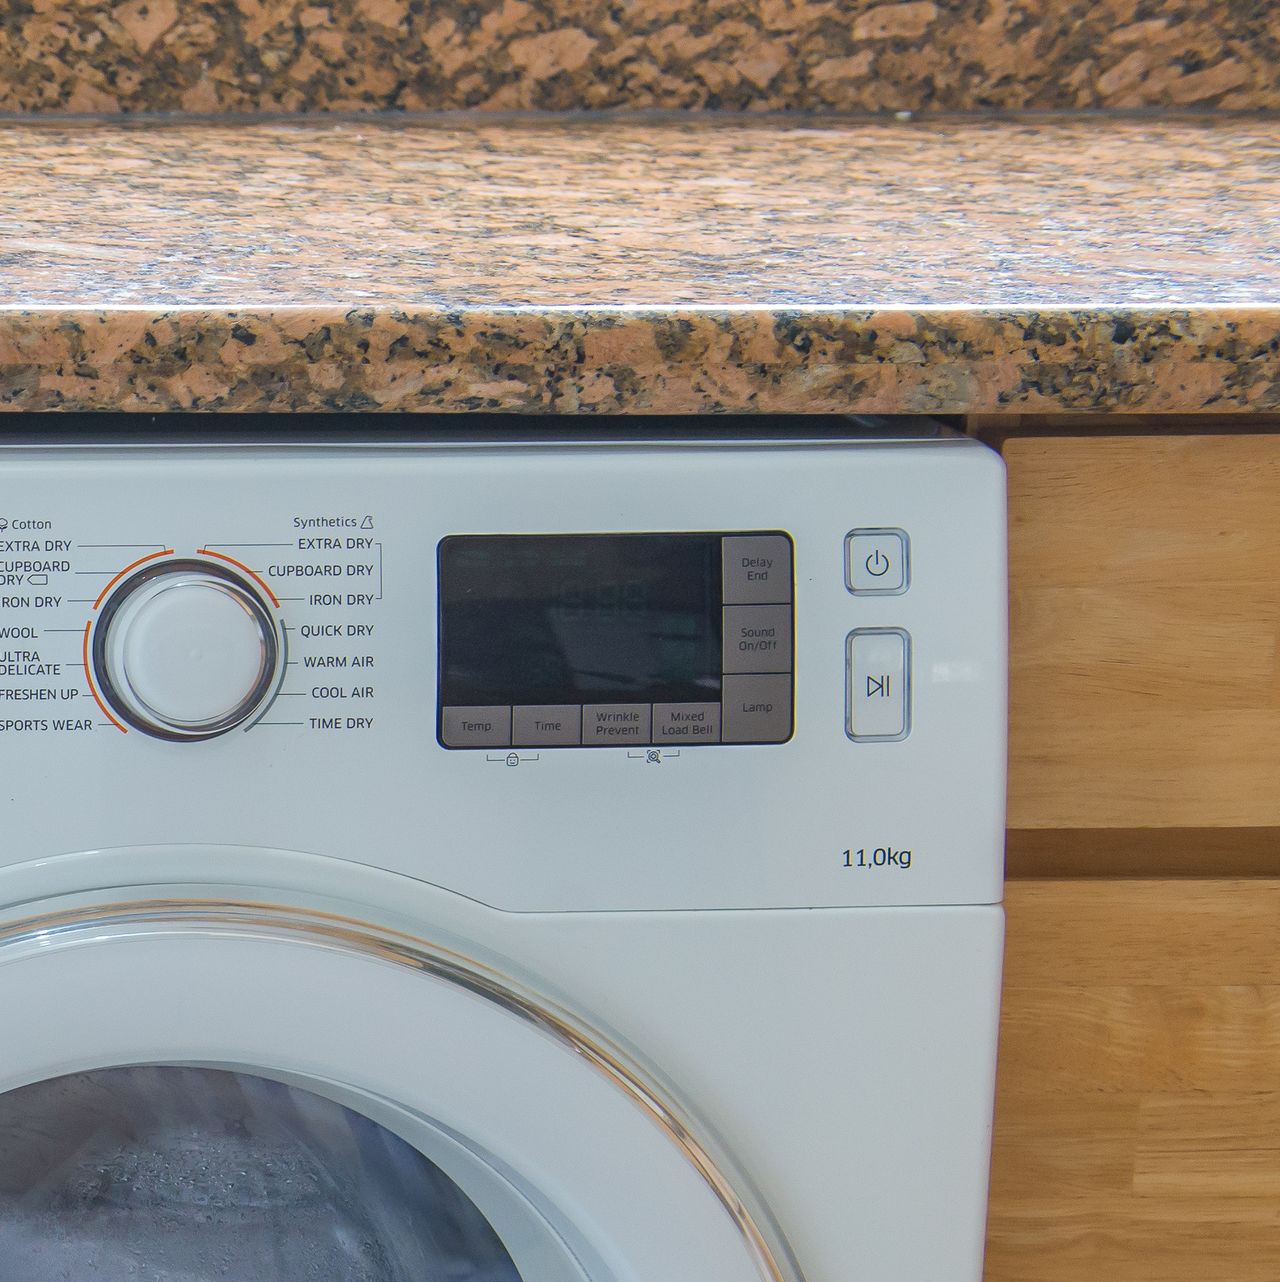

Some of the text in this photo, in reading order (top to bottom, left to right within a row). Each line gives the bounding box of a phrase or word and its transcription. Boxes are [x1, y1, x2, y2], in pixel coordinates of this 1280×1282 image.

[11, 518, 52, 530] Cotton
[293, 516, 357, 529] Synthetics
[45, 540, 72, 552] DRY
[298, 538, 374, 550] EXTRA DRY
[741, 557, 773, 569] Delay
[268, 565, 374, 577] CUPBOARD DRY
[747, 571, 768, 581] End
[34, 596, 62, 608] DRY
[309, 594, 374, 606] IRON DRY
[300, 625, 374, 637] QUICK DRY
[741, 627, 775, 637] Sound
[738, 640, 777, 651] On/Off
[303, 656, 374, 668] WARM AIR
[60, 689, 79, 700] UP
[311, 687, 374, 698] COOL AIR
[742, 702, 773, 714] Lamp
[596, 712, 640, 722] Wrinkle
[670, 711, 705, 722] Mixed
[51, 719, 93, 731] WEAR
[309, 717, 373, 729] TIME DRY
[461, 721, 494, 733] Temp.
[534, 721, 561, 731] Time
[596, 725, 640, 736] Prevent
[662, 724, 713, 735] Load Bell
[842, 847, 912, 870] 11,0kg
